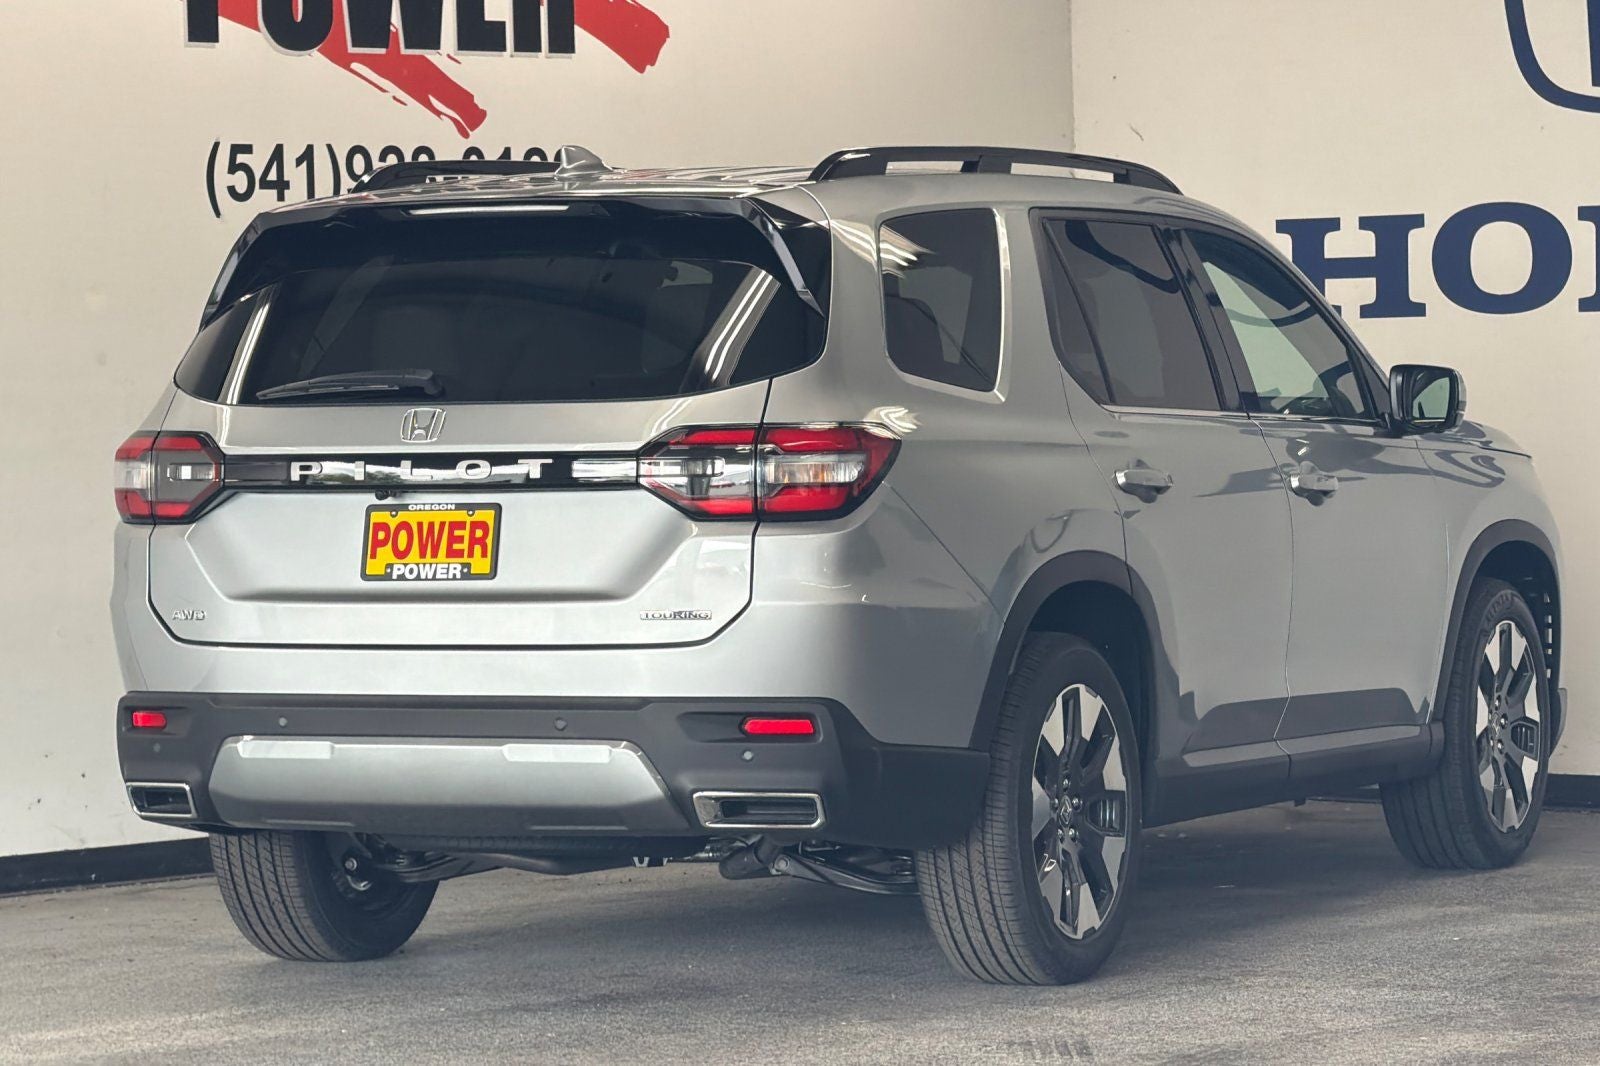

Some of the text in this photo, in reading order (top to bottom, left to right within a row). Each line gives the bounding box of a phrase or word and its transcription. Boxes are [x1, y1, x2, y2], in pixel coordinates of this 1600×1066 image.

[1275, 201, 1600, 319] HO
[290, 458, 553, 481] PILOT
[408, 503, 456, 511] OREGON
[369, 520, 490, 560] POWER
[391, 563, 462, 580] POWER
[172, 609, 206, 621] AWD
[641, 610, 711, 620] TOURING
